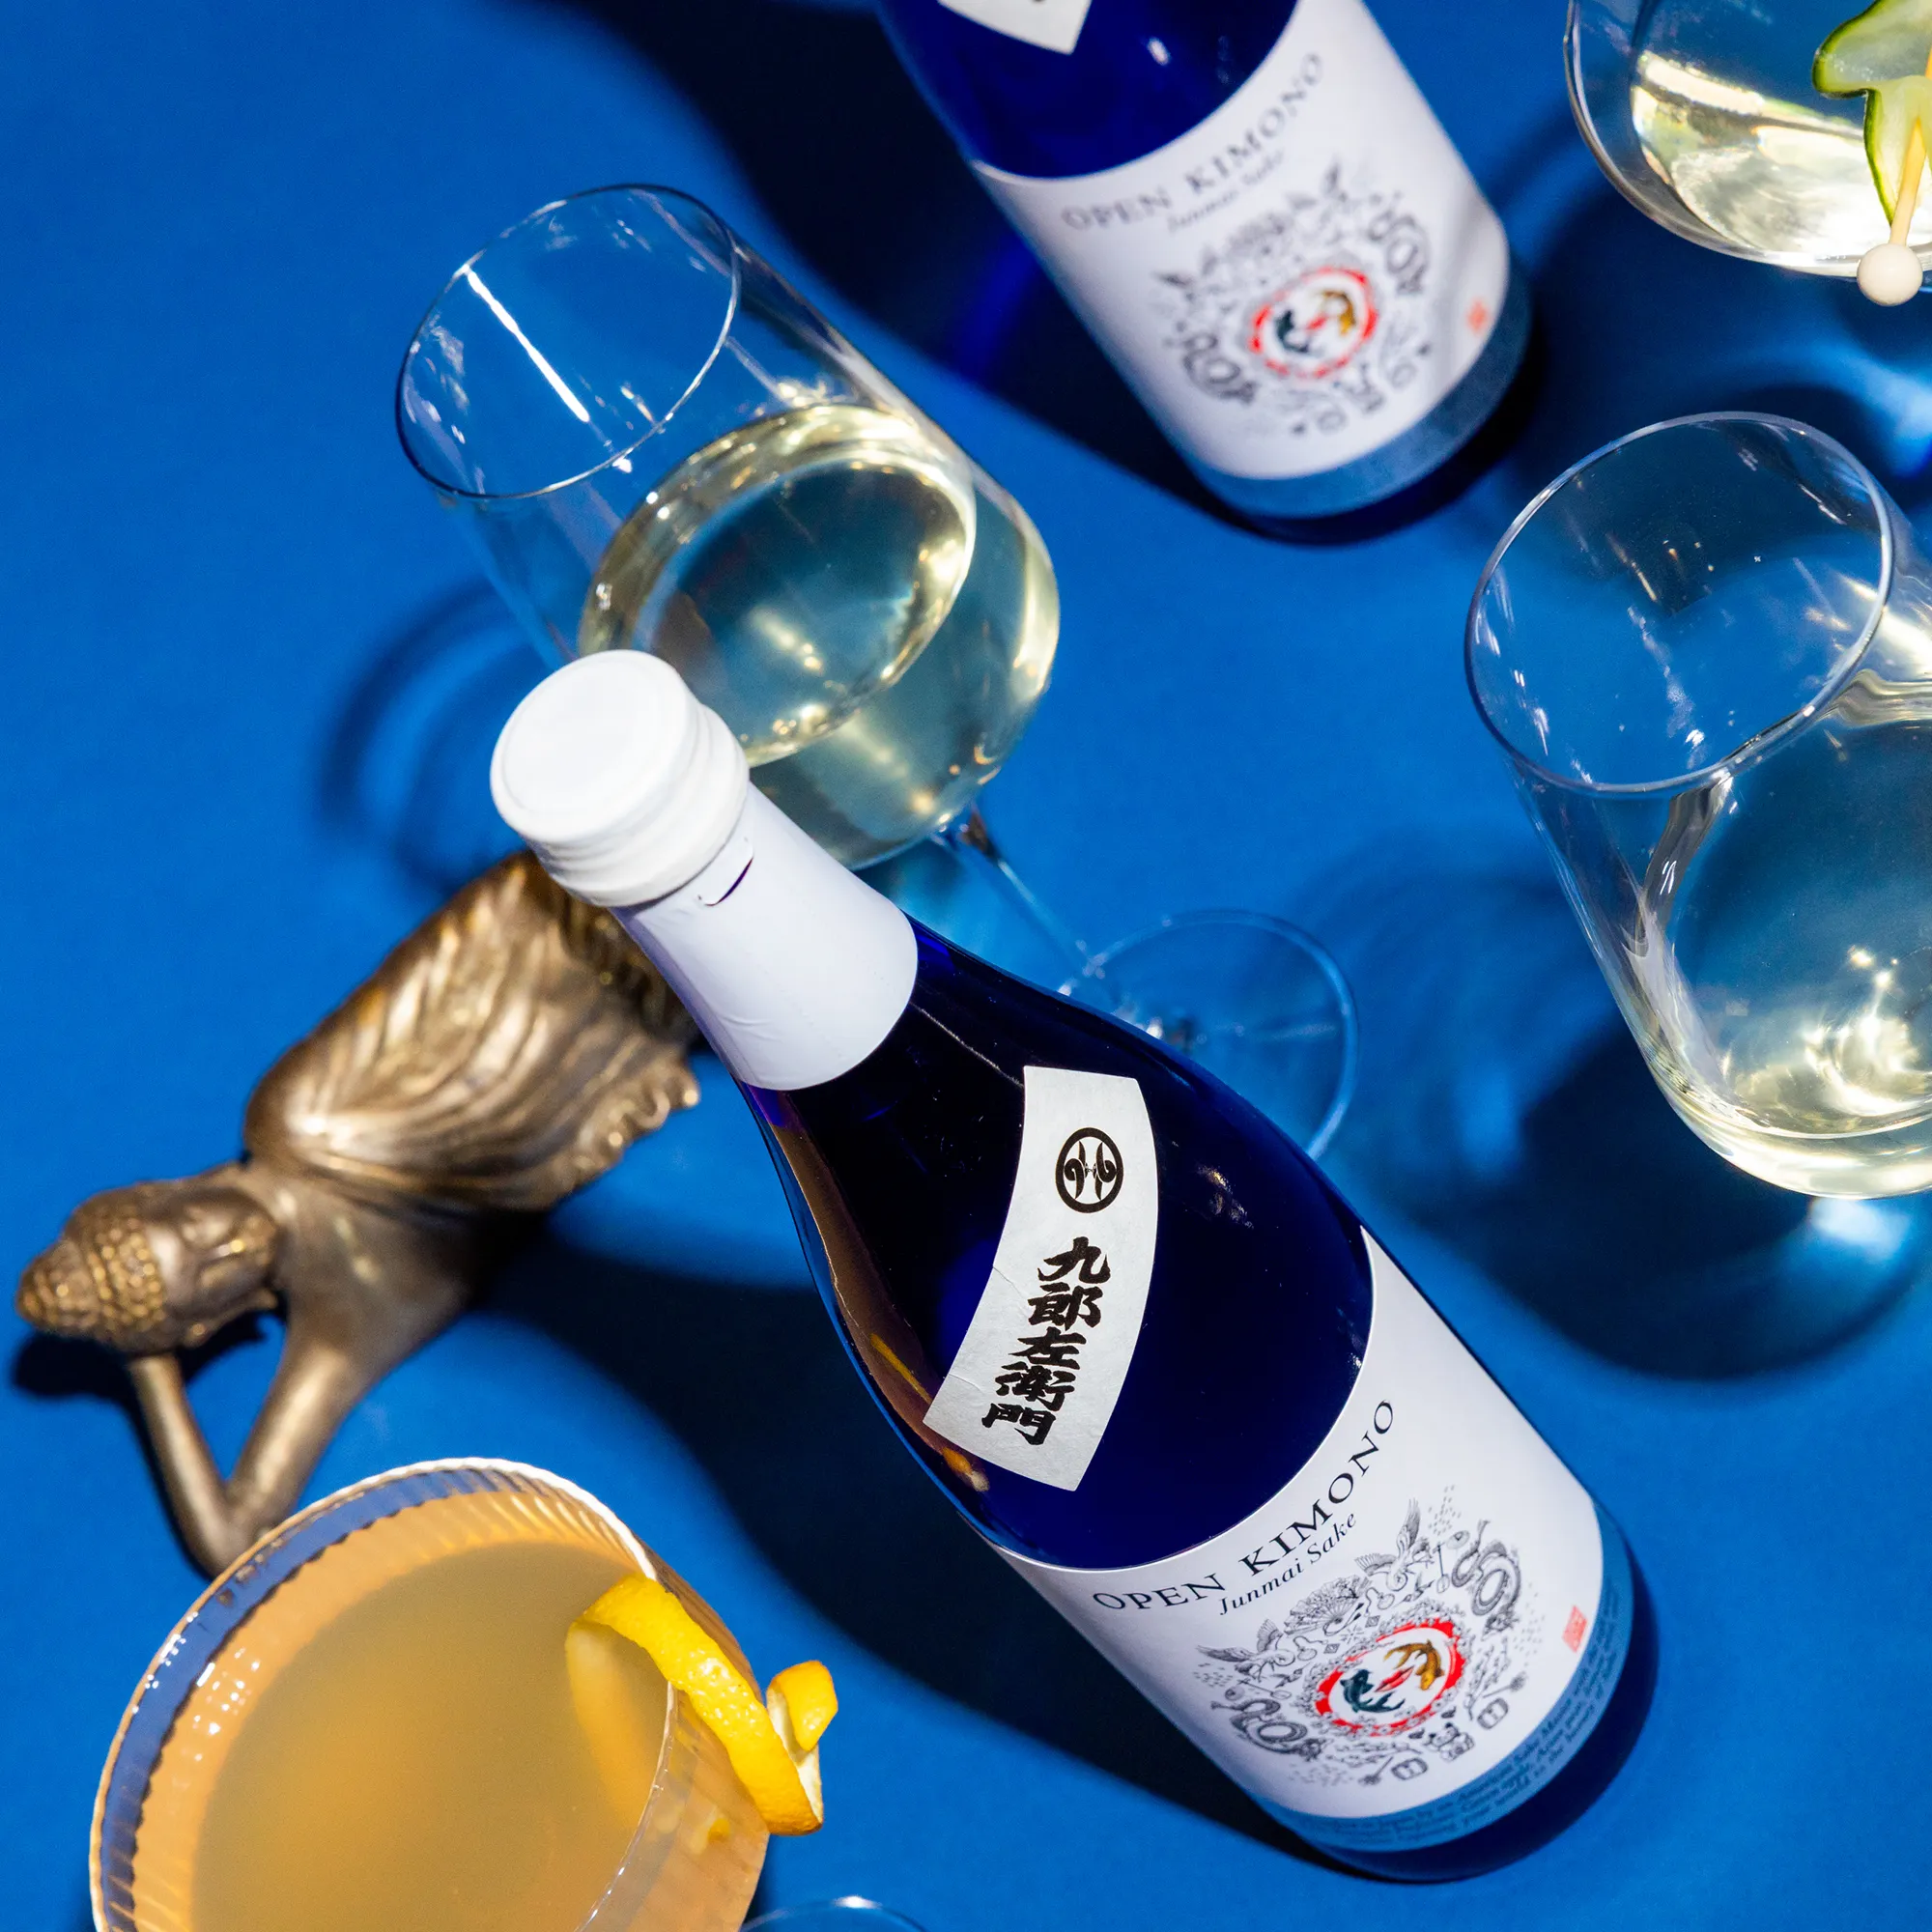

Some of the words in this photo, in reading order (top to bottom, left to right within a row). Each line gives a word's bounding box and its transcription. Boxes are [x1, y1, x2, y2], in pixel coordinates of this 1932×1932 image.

[1061, 185, 1174, 232] OPEN
[1183, 51, 1323, 194] KIMONO
[980, 1236, 1112, 1446] 九郎左衛門
[1093, 1573, 1226, 1610] OPEN
[1238, 1399, 1394, 1577] KIMONO
[1219, 1557, 1304, 1616] Junmai
[1306, 1512, 1357, 1565] Sake
